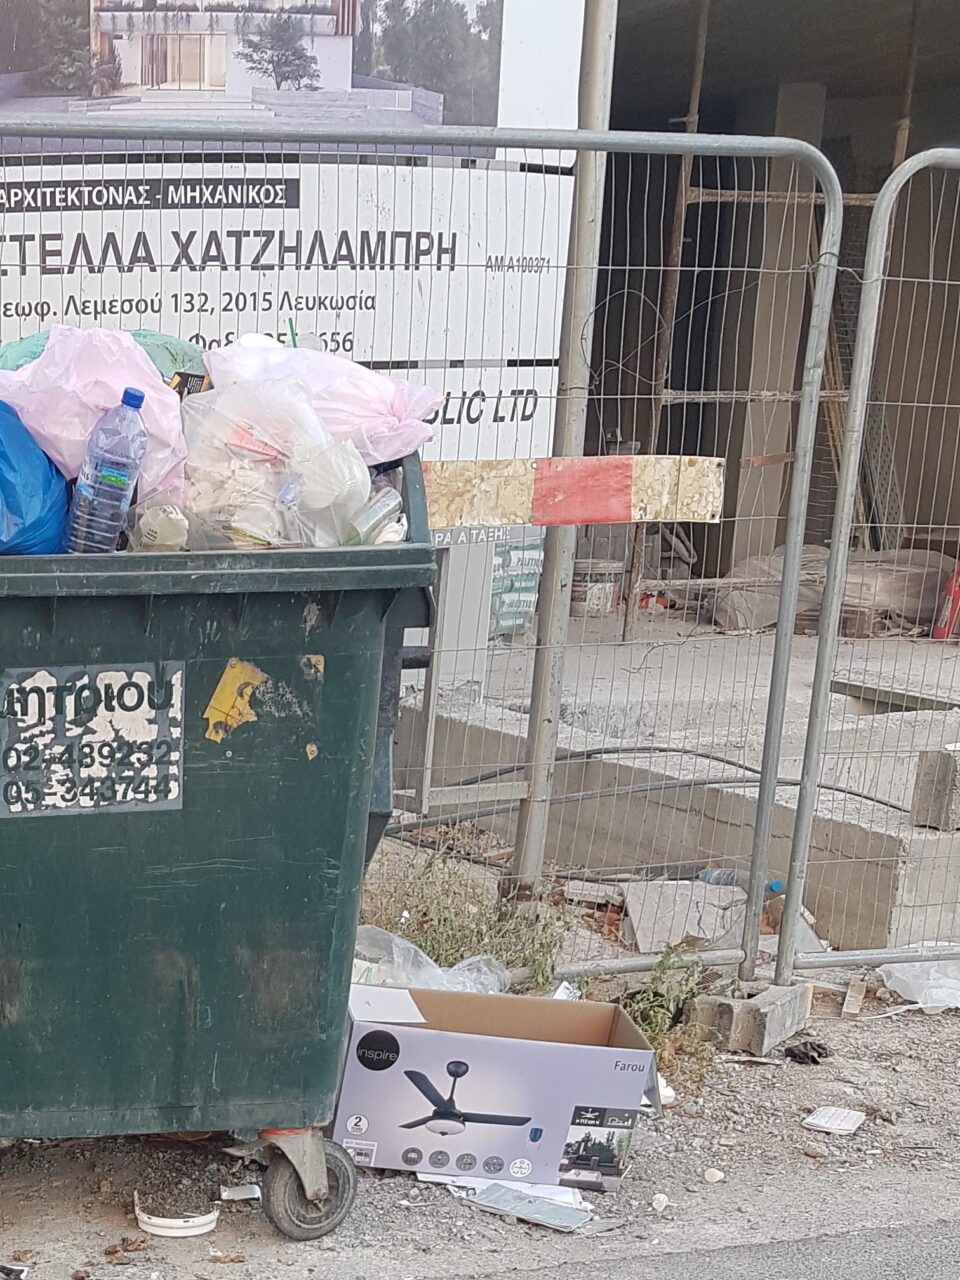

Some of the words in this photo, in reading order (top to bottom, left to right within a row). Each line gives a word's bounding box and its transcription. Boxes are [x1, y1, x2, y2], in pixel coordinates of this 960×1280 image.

[167, 184, 286, 205] ΜΗΧΑΝΙΚΟΣ
[170, 230, 457, 272] ΧΑΤΖΗΛΑΜΠΡΗ
[64, 292, 162, 321] Λεμεσού
[170, 292, 215, 316] 132,
[221, 291, 273, 313] 2015
[279, 290, 376, 312] Λευκωσία
[492, 388, 538, 423] LTD
[357, 1046, 398, 1061] inspire
[614, 1060, 646, 1072] Farou
[353, 1116, 362, 1127] 2
